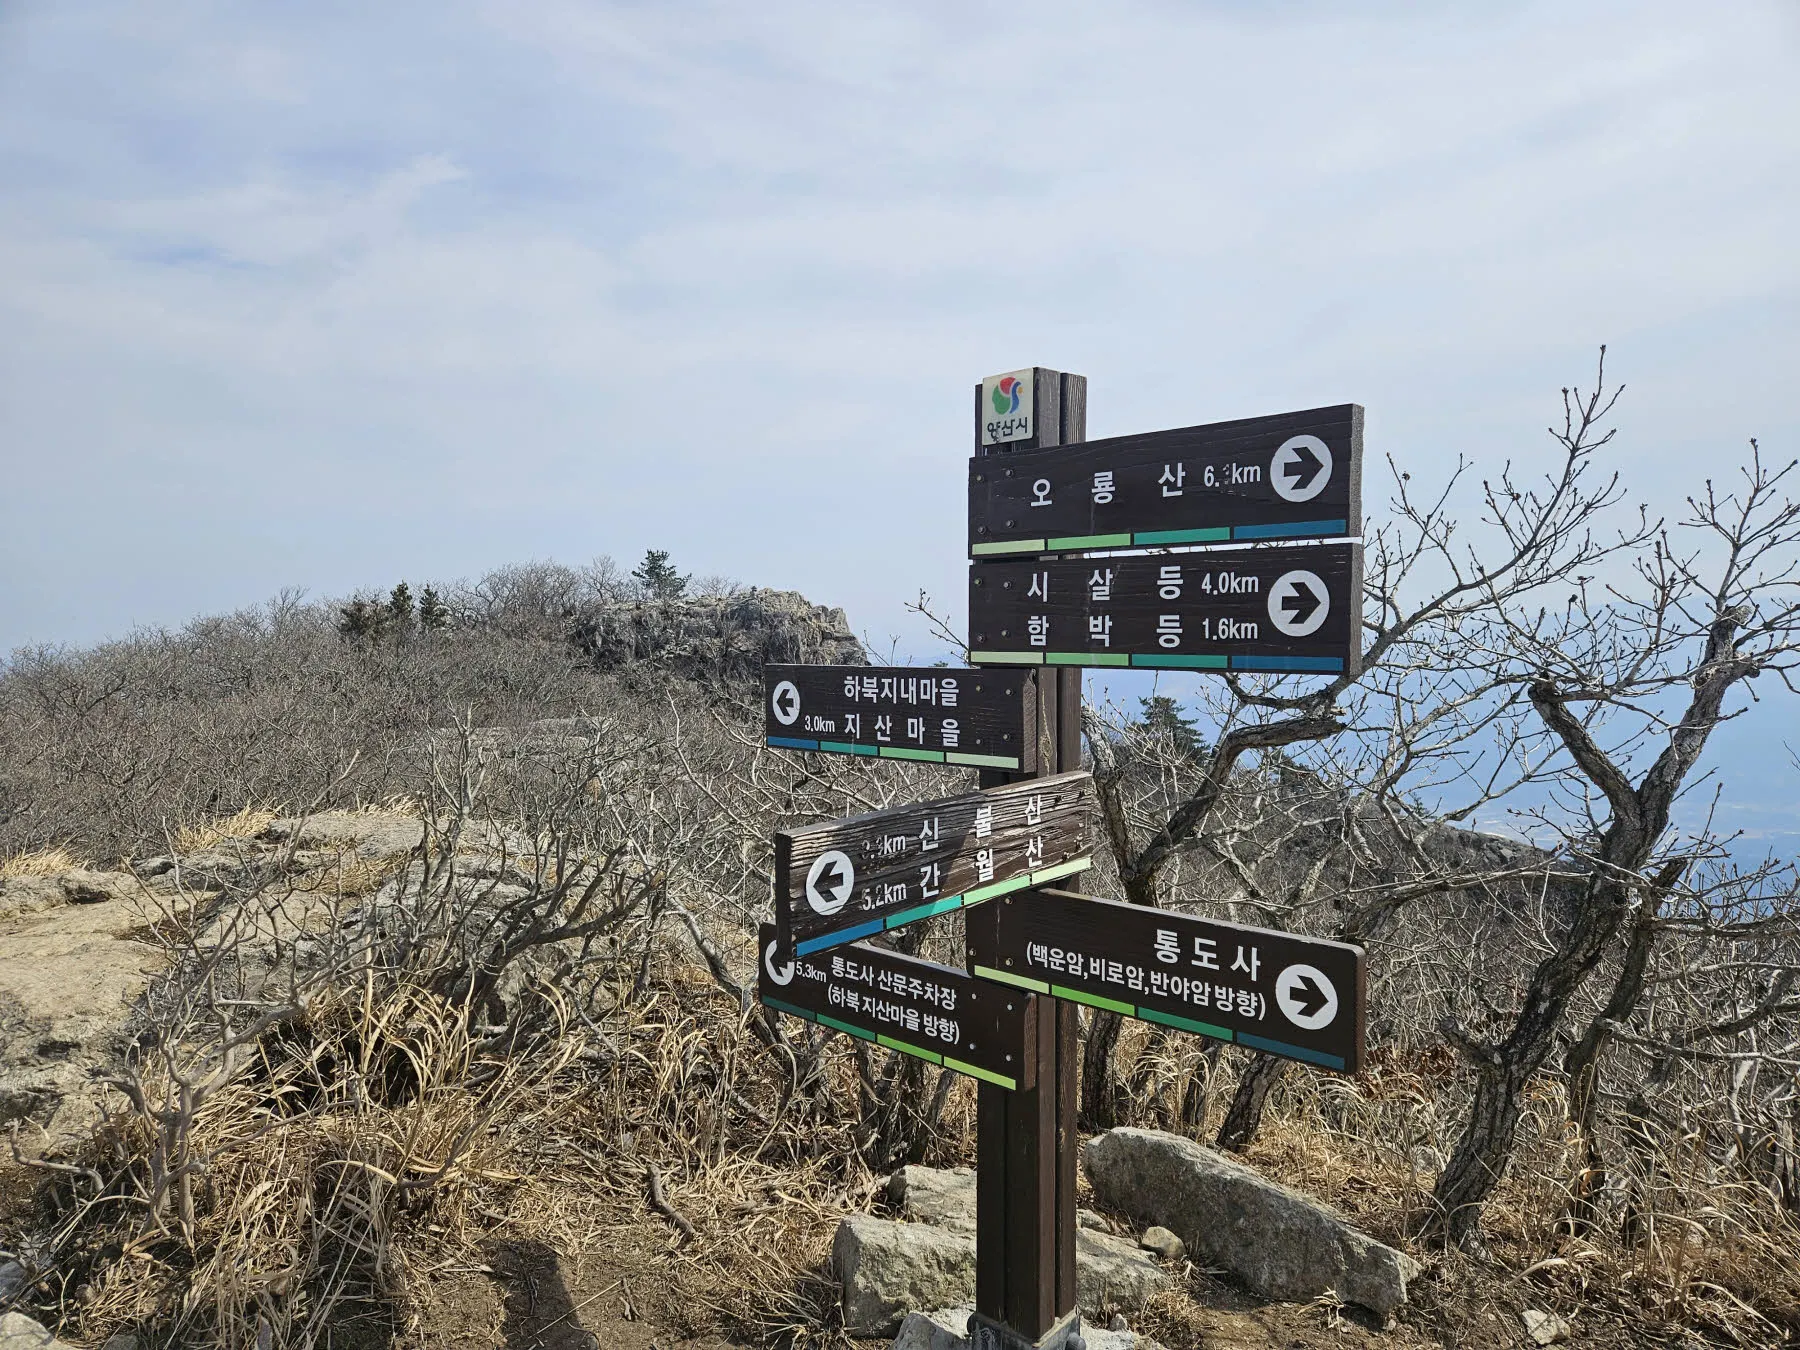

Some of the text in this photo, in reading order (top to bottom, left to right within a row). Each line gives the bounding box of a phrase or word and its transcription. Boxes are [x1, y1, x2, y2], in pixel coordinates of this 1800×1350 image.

[987, 417, 1027, 444] 양산시
[1202, 572, 1258, 595] 4.0km
[1203, 618, 1257, 640] 1.6km
[844, 676, 959, 706] 하북지내마을
[805, 715, 835, 732] 3.0km
[862, 884, 907, 911] 5.2km
[796, 955, 957, 1010] 5.3km 통도사 산문주차장
[828, 984, 959, 1044] (하북 지산마을 방향)
[1215, 985, 1265, 1020] 방향)
